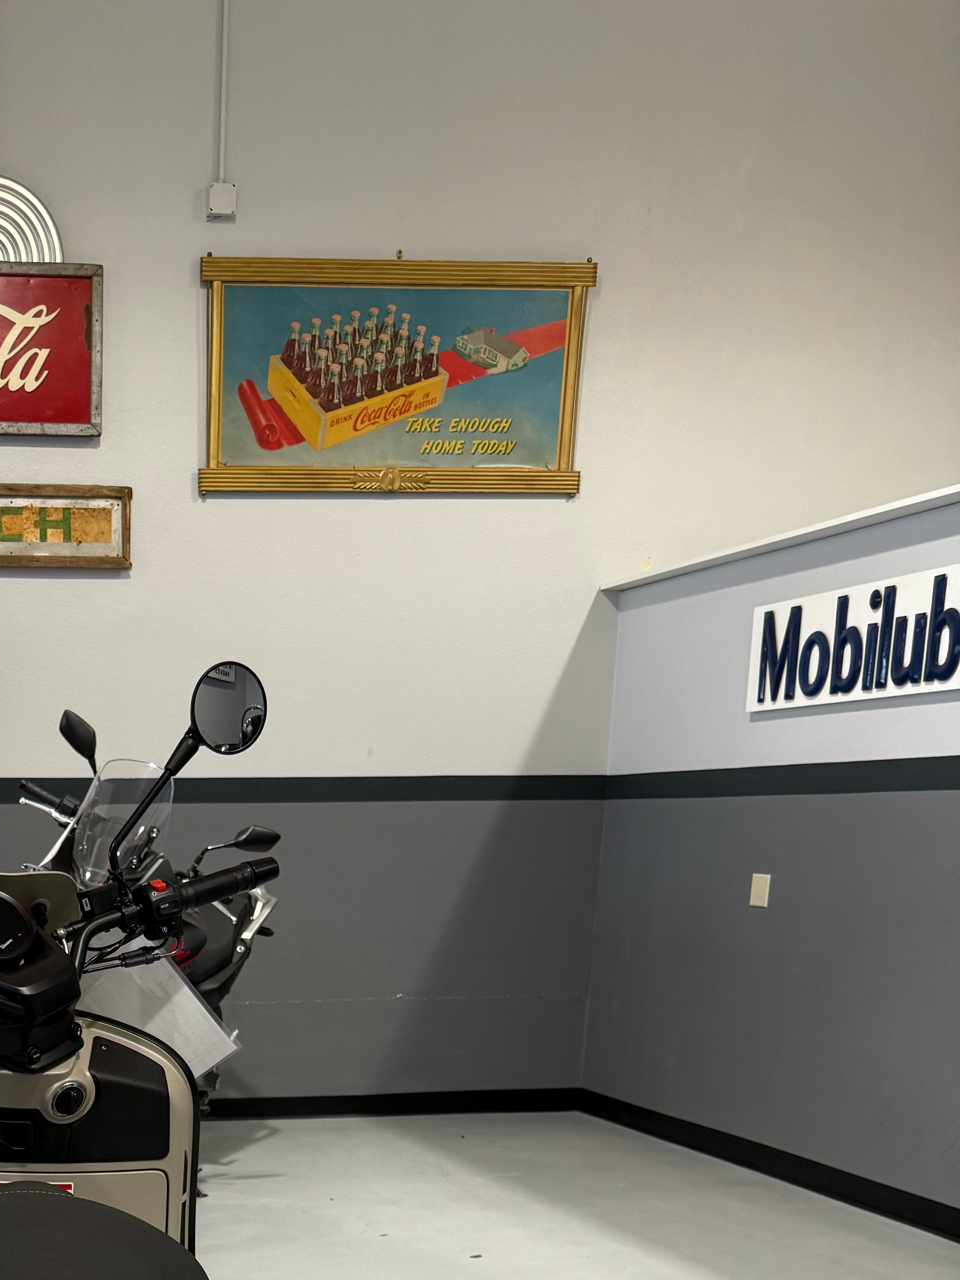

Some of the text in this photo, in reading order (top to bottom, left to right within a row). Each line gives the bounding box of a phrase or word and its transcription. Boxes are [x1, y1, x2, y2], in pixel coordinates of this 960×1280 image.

[422, 392, 430, 400] IN
[330, 390, 416, 432] DRINK Coca-Cola
[413, 397, 438, 412] BOTTLES
[405, 417, 443, 433] TAKE
[448, 417, 513, 433] ENOUGH
[420, 440, 517, 456] HOME TODAY
